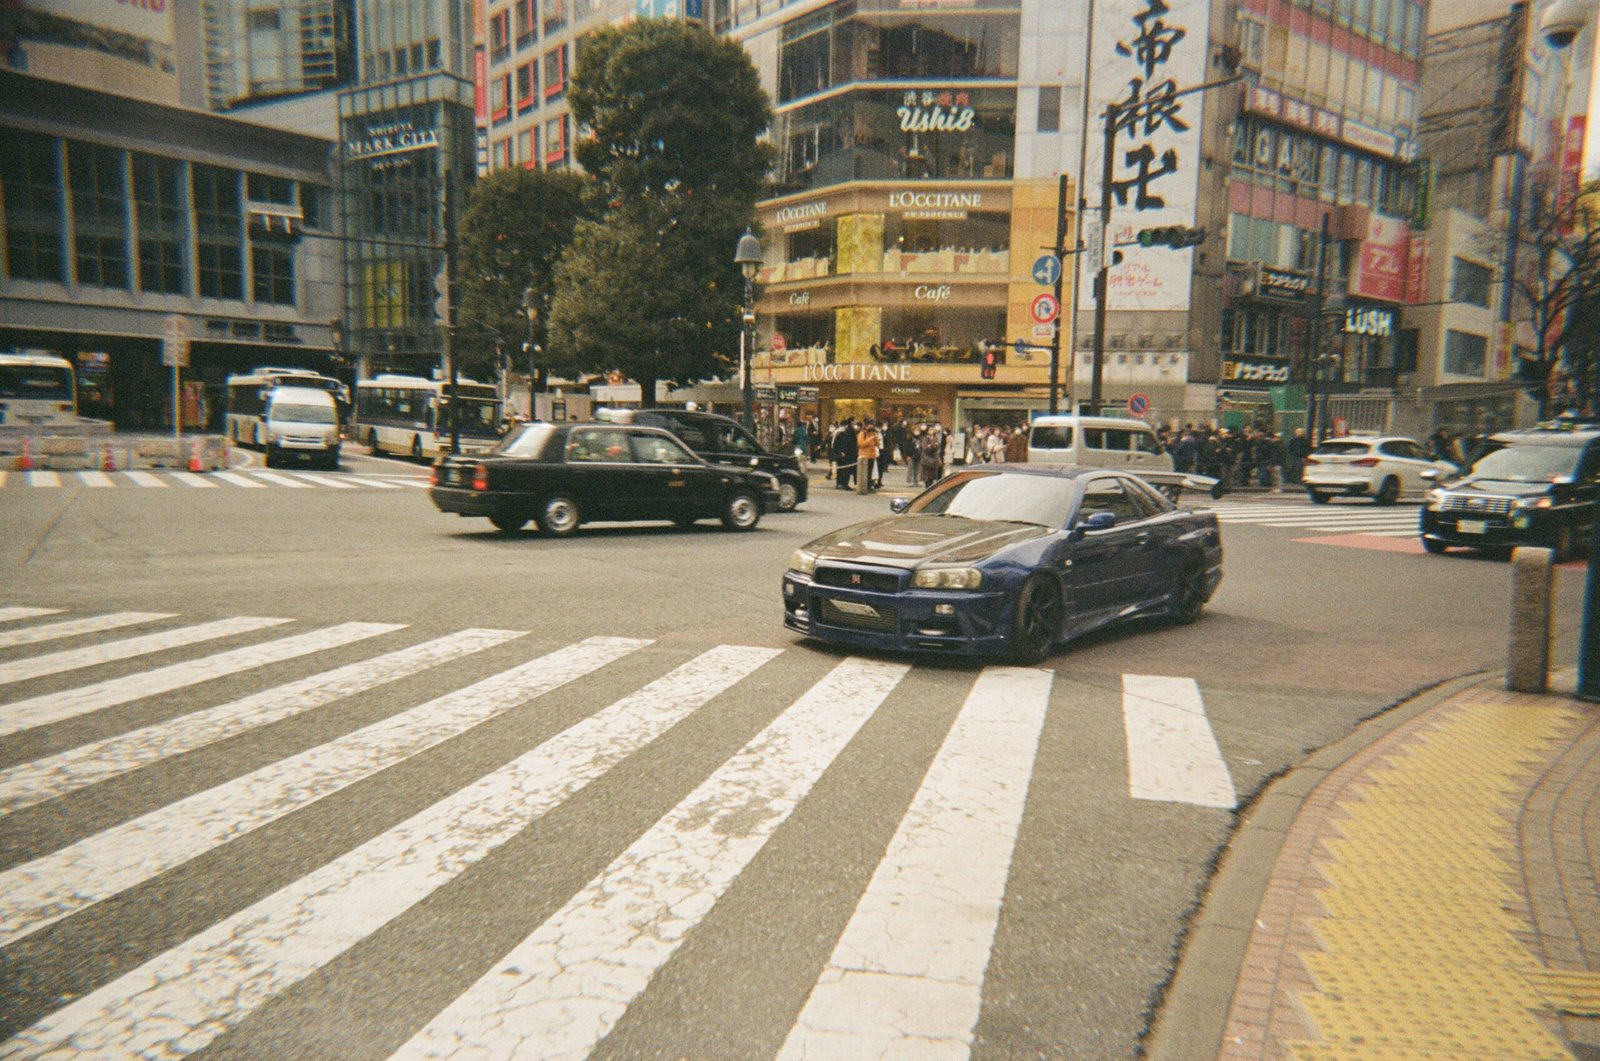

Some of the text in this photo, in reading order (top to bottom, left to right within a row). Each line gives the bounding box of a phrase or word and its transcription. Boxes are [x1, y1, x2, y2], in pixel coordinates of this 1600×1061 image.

[896, 106, 975, 132] Ushi8
[348, 129, 439, 154] MARK CITY
[888, 191, 982, 208] L'OCCITANE
[776, 202, 828, 224] L'OCCITANE
[789, 292, 810, 305] Café
[914, 285, 951, 302] Café
[1345, 307, 1393, 336] LUSH
